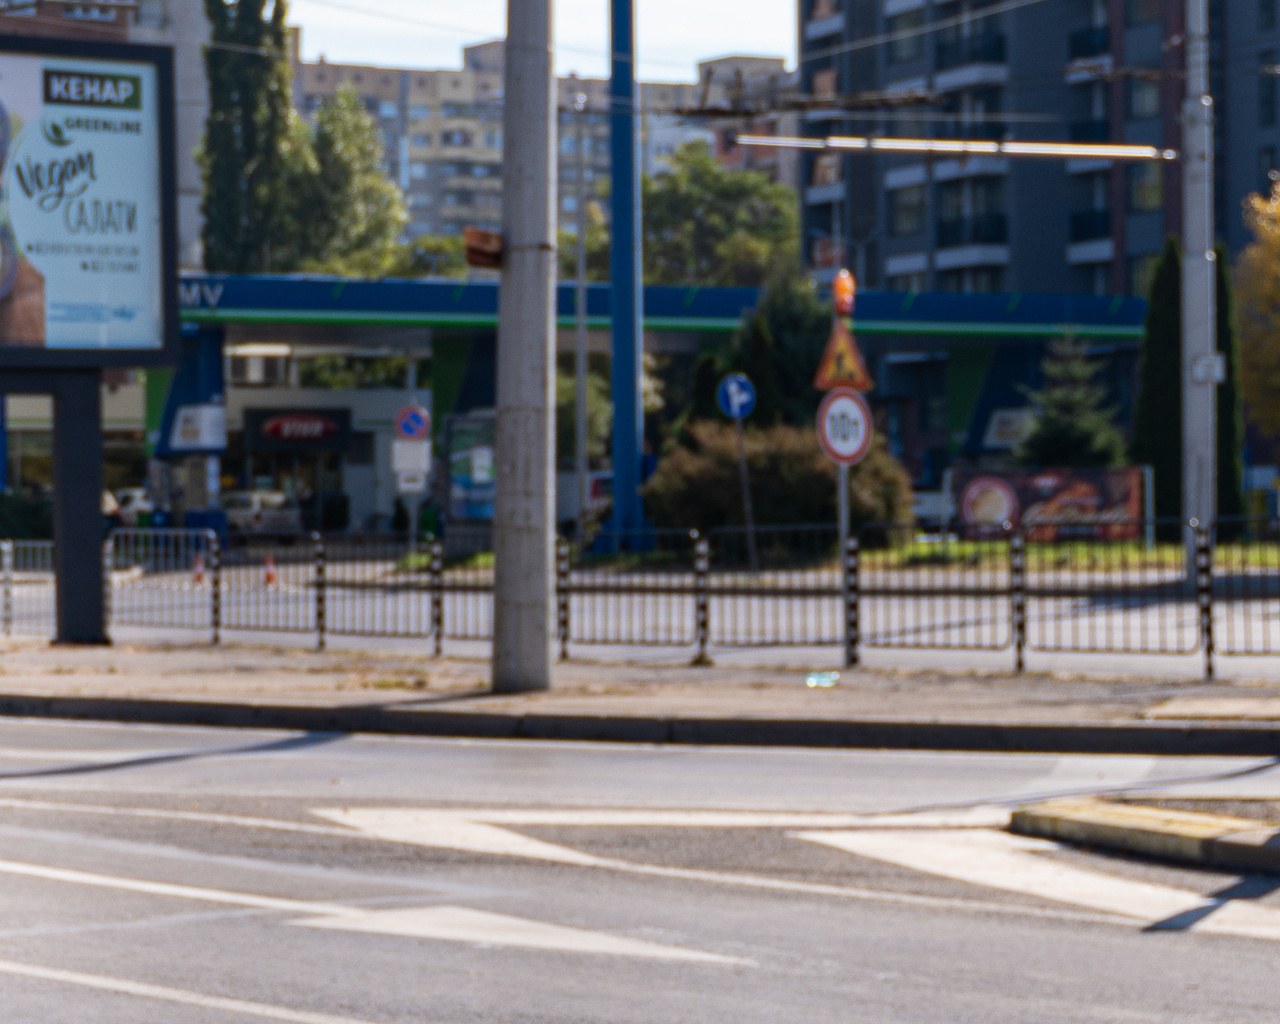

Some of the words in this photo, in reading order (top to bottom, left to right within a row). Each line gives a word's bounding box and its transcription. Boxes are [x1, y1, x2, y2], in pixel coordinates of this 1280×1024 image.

[50, 75, 134, 104] КЕНАР
[64, 118, 142, 136] GREENLINE
[15, 151, 97, 213] Vegan
[178, 282, 224, 307] MV
